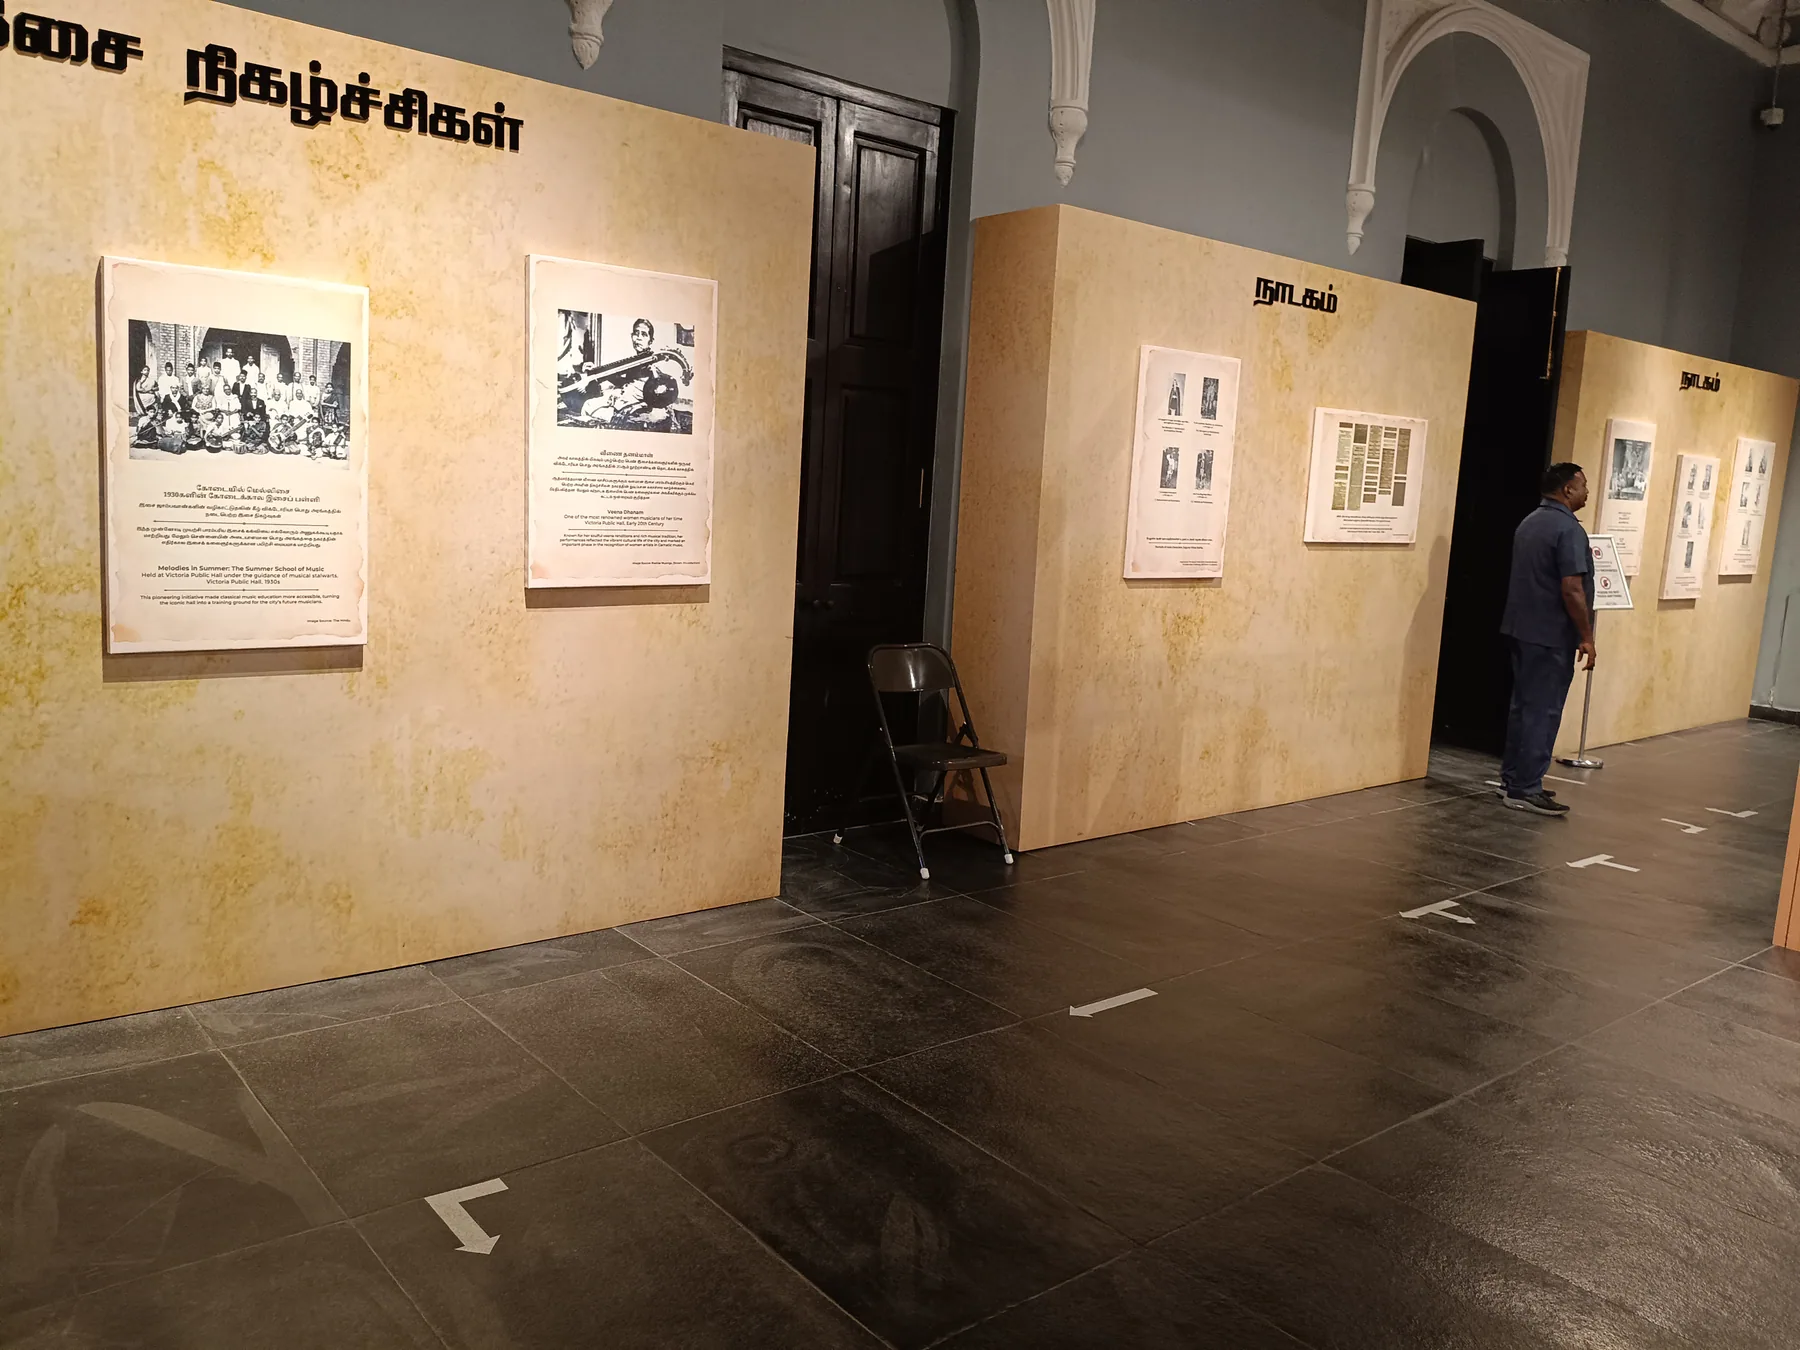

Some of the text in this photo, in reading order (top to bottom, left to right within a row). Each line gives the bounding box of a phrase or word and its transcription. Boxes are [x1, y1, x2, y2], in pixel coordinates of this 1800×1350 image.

[0, 0, 524, 151] சை நிகழ்ச்சிகள்
[1253, 276, 1338, 314] நாடகம்
[1679, 370, 1721, 392] நாடகம்
